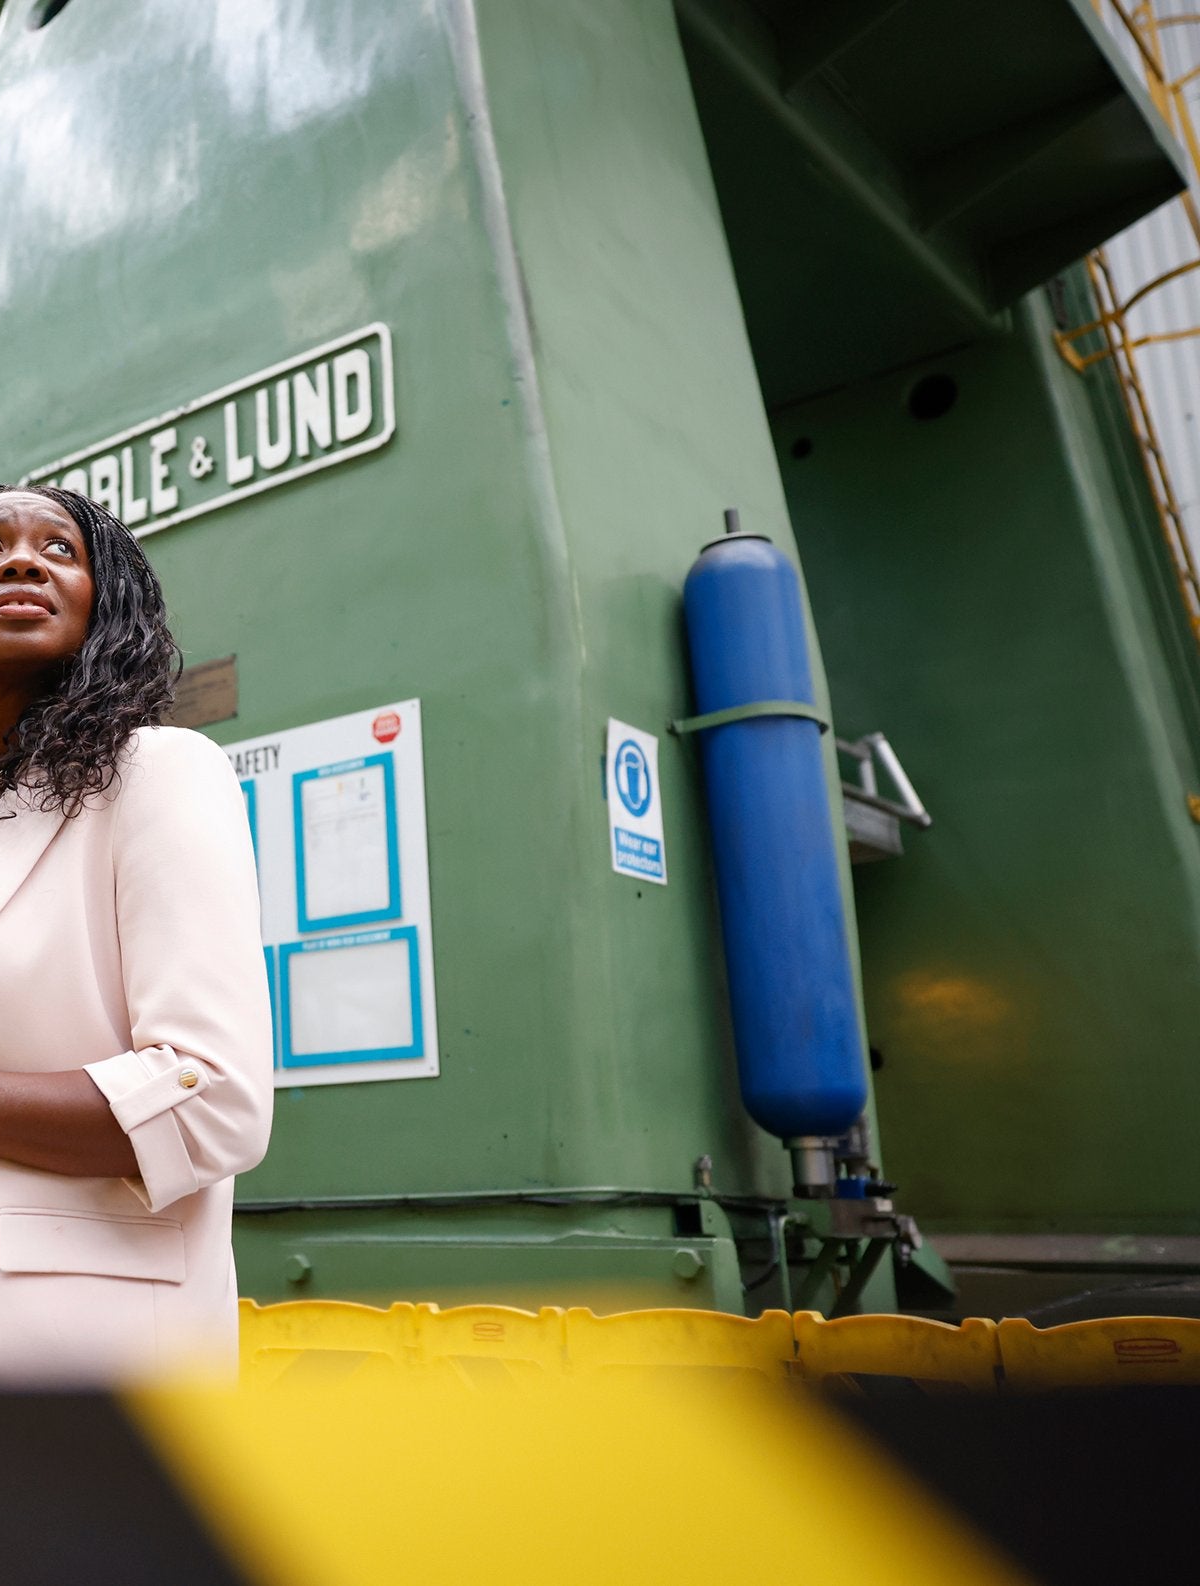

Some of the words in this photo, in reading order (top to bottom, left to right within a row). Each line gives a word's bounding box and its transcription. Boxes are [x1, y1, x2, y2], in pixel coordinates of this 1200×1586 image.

[47, 428, 178, 525] BLE
[188, 436, 214, 479] &
[224, 348, 373, 486] LUND
[227, 742, 281, 776] AFETY
[618, 831, 641, 851] Wear
